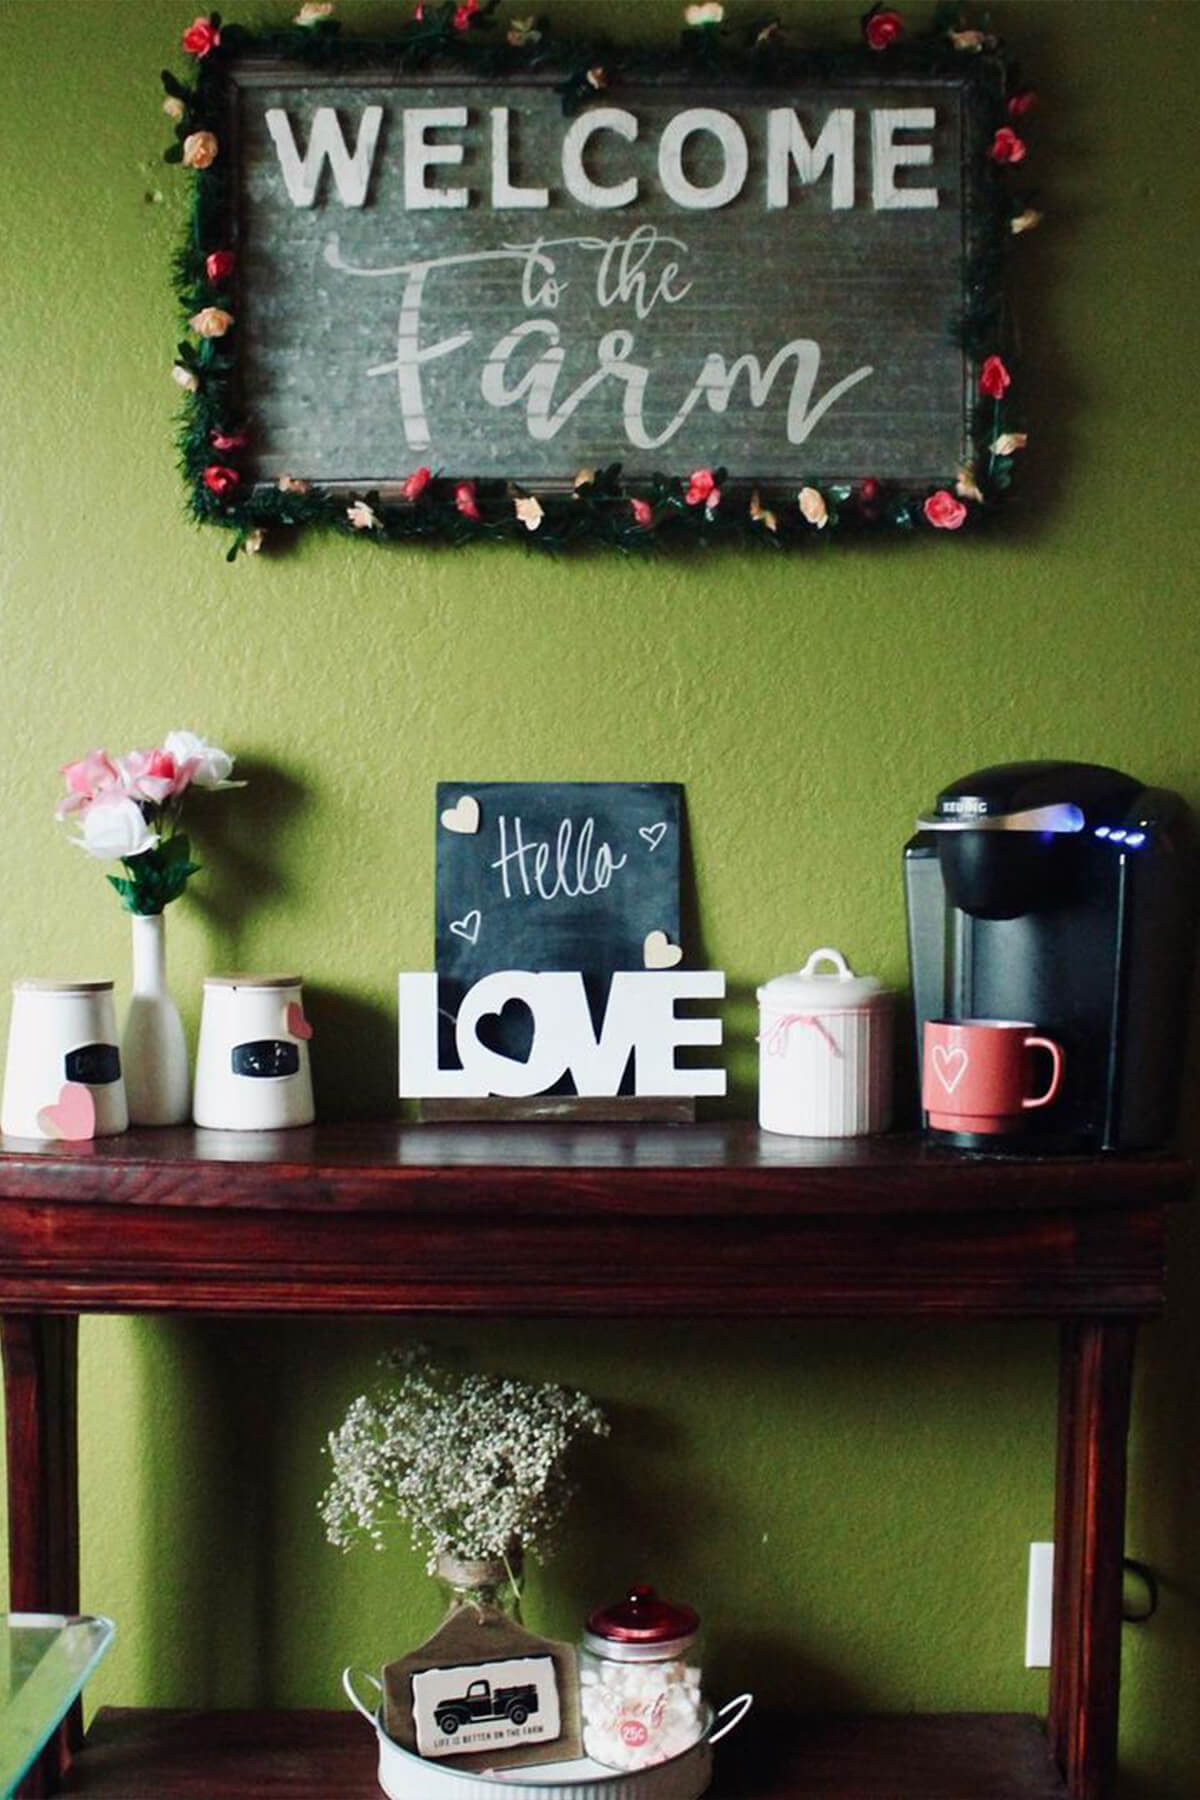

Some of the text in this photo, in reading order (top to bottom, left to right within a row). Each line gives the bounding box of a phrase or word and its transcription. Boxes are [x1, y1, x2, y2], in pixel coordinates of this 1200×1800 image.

[265, 105, 940, 211] WELCOME
[505, 223, 694, 319] to the
[323, 231, 875, 453] Farm
[491, 815, 628, 900] Hello
[398, 970, 728, 1099] LOVE
[433, 1725, 545, 1748] LIFE IS BETTER ON THE FARM
